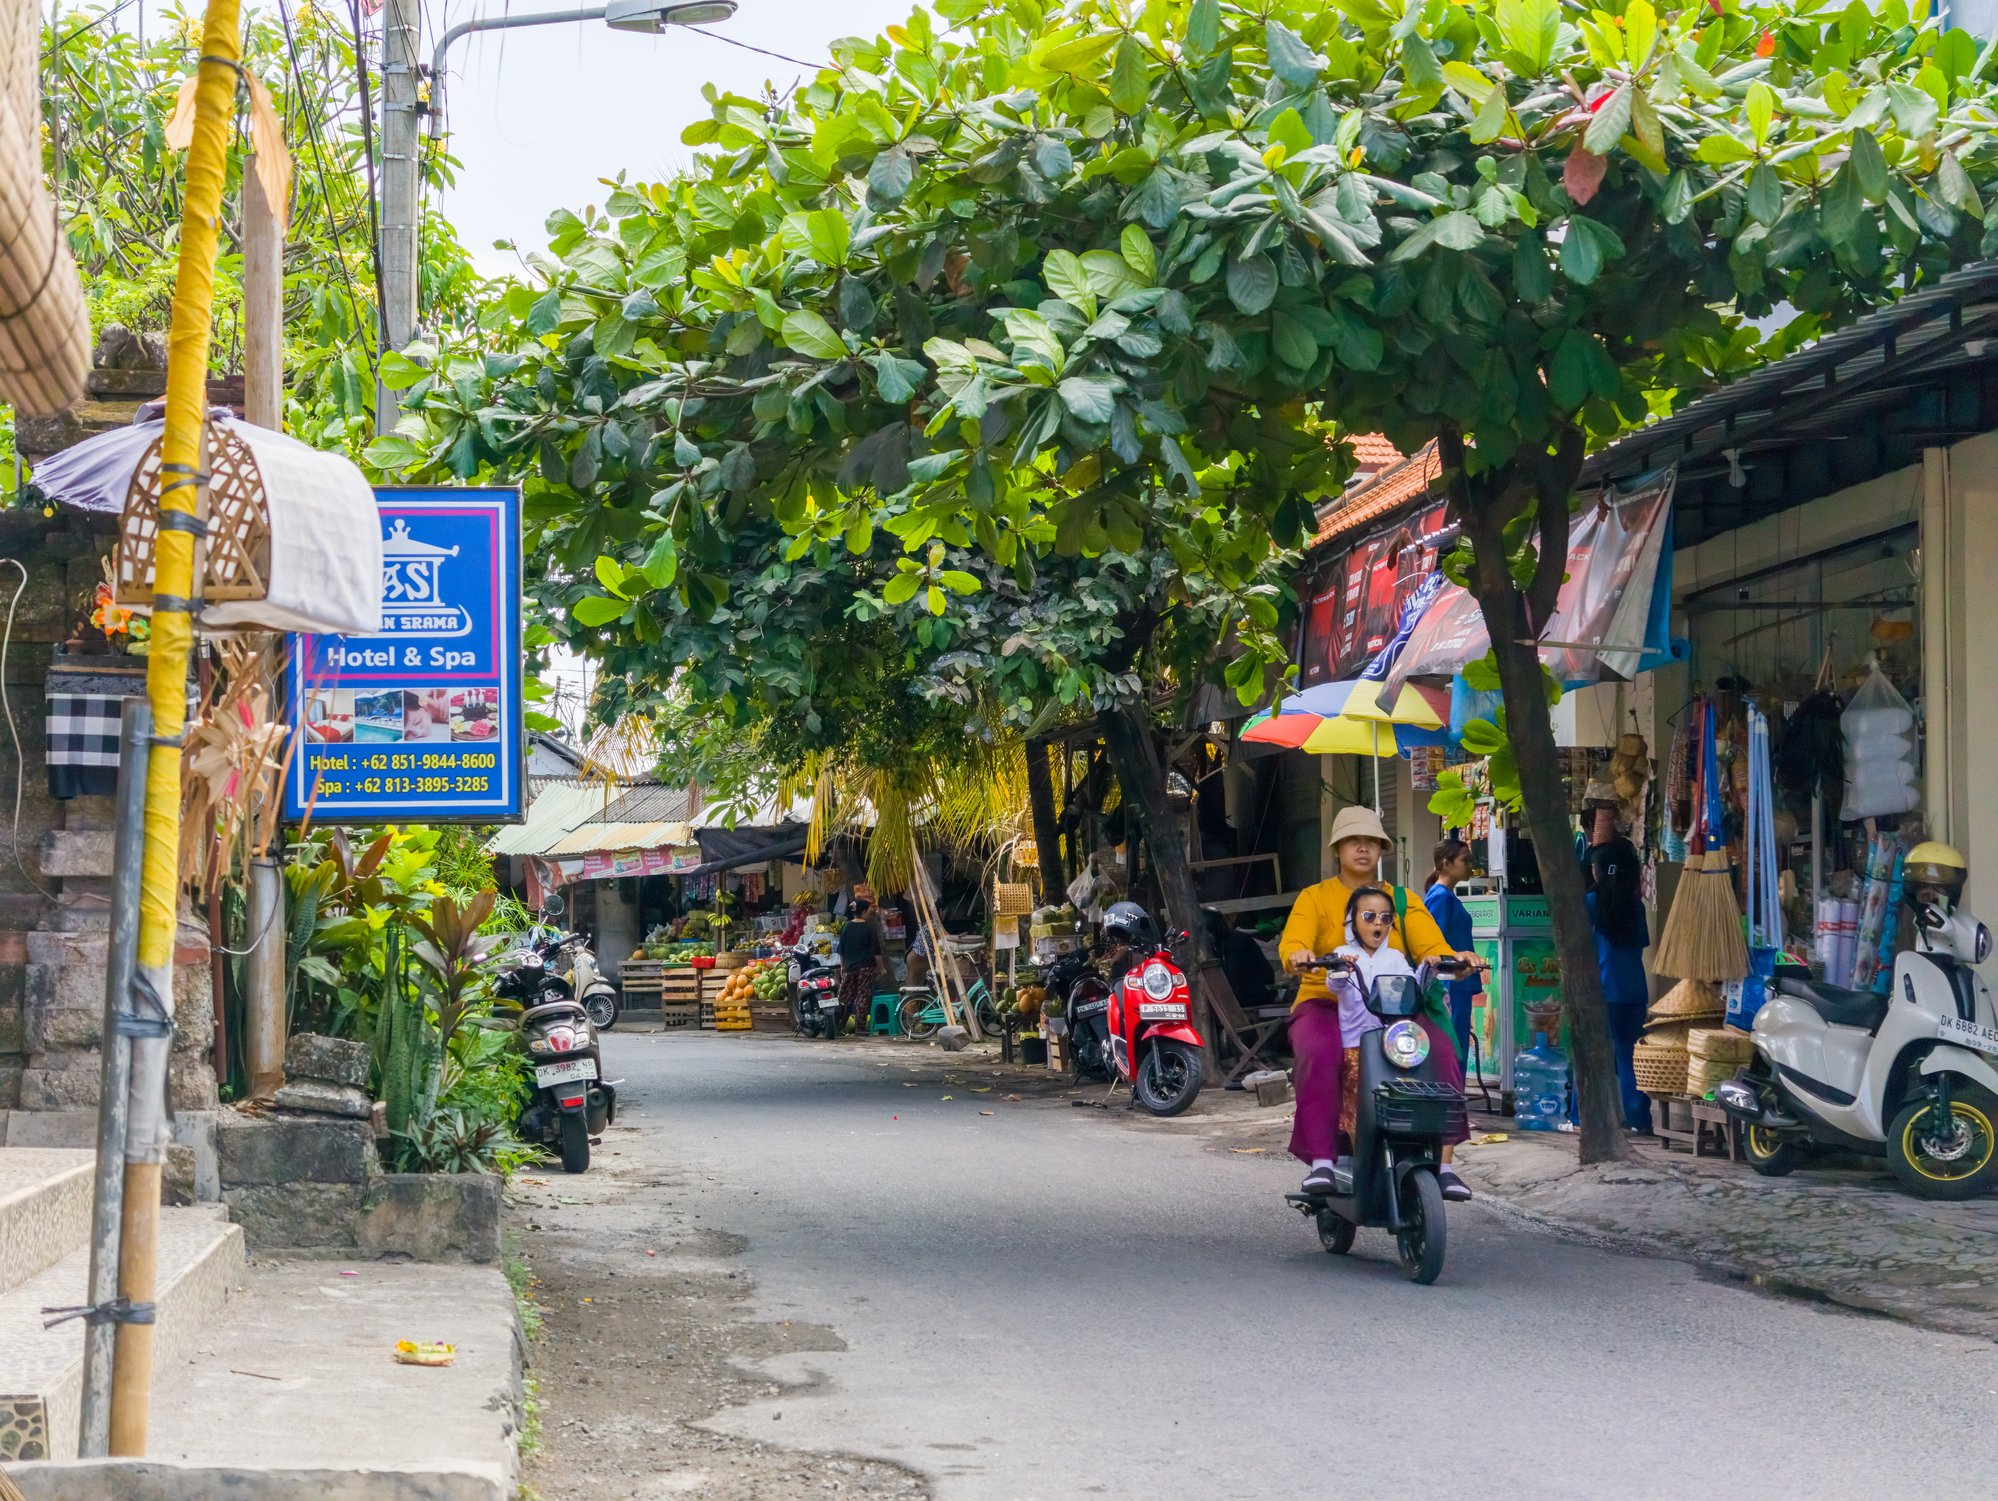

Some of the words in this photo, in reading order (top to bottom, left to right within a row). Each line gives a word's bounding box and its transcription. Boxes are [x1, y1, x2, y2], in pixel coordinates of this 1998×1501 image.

[400, 616, 459, 629] SRAMA
[328, 647, 395, 667] Hotel
[403, 647, 422, 666] &
[430, 647, 476, 670] Spa
[310, 754, 349, 770] Hotel
[361, 755, 387, 770] +62
[391, 753, 496, 769] 851-9844-8600
[317, 778, 342, 797] Spa
[355, 777, 381, 793] +62
[384, 776, 489, 793] 813-3895-3285
[1512, 909, 1550, 918] VARIAN
[1941, 1014, 1952, 1028] DK
[538, 1067, 549, 1077] DK
